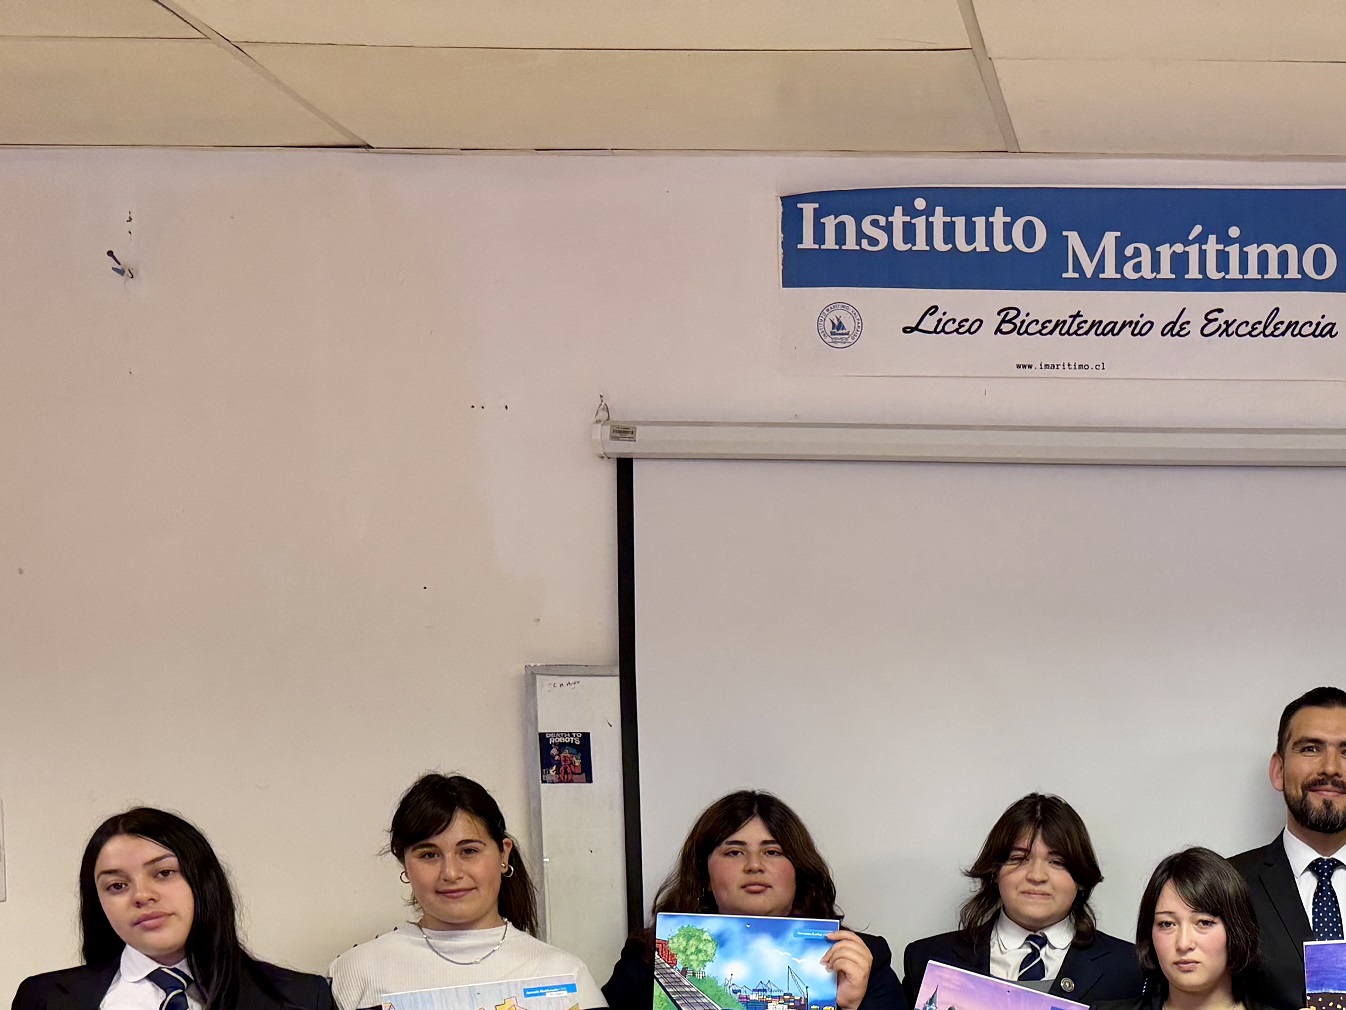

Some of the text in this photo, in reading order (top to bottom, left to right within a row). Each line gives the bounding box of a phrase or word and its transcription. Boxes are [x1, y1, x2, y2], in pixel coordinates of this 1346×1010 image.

[798, 198, 1338, 280] Instituto Marítimo
[902, 305, 1339, 339] Liceo Bicentenario de Excelencia
[1015, 361, 1106, 371] www.imaritimo.cl
